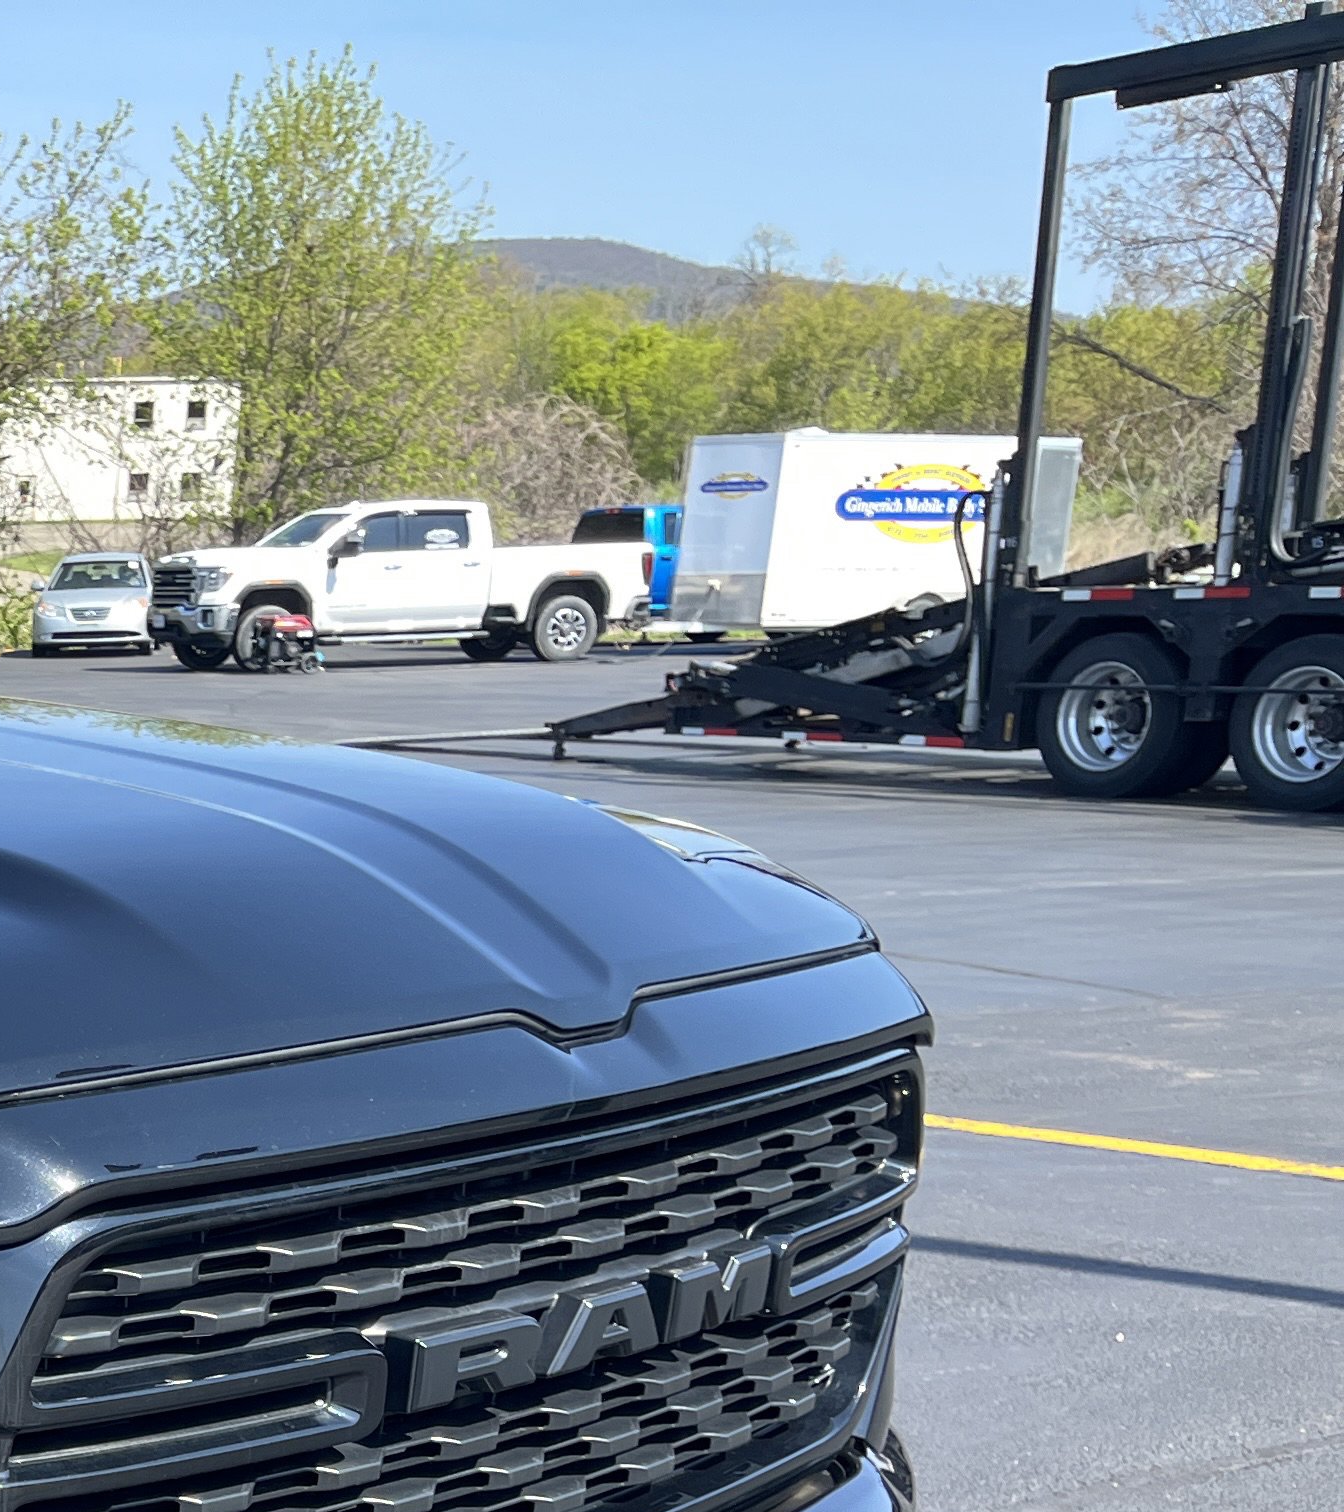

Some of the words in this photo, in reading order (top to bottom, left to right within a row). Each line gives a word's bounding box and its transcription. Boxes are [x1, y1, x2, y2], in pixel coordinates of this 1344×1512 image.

[905, 496, 946, 515] Mobile
[946, 496, 976, 519] Bdy
[386, 1237, 773, 1414] RAM
